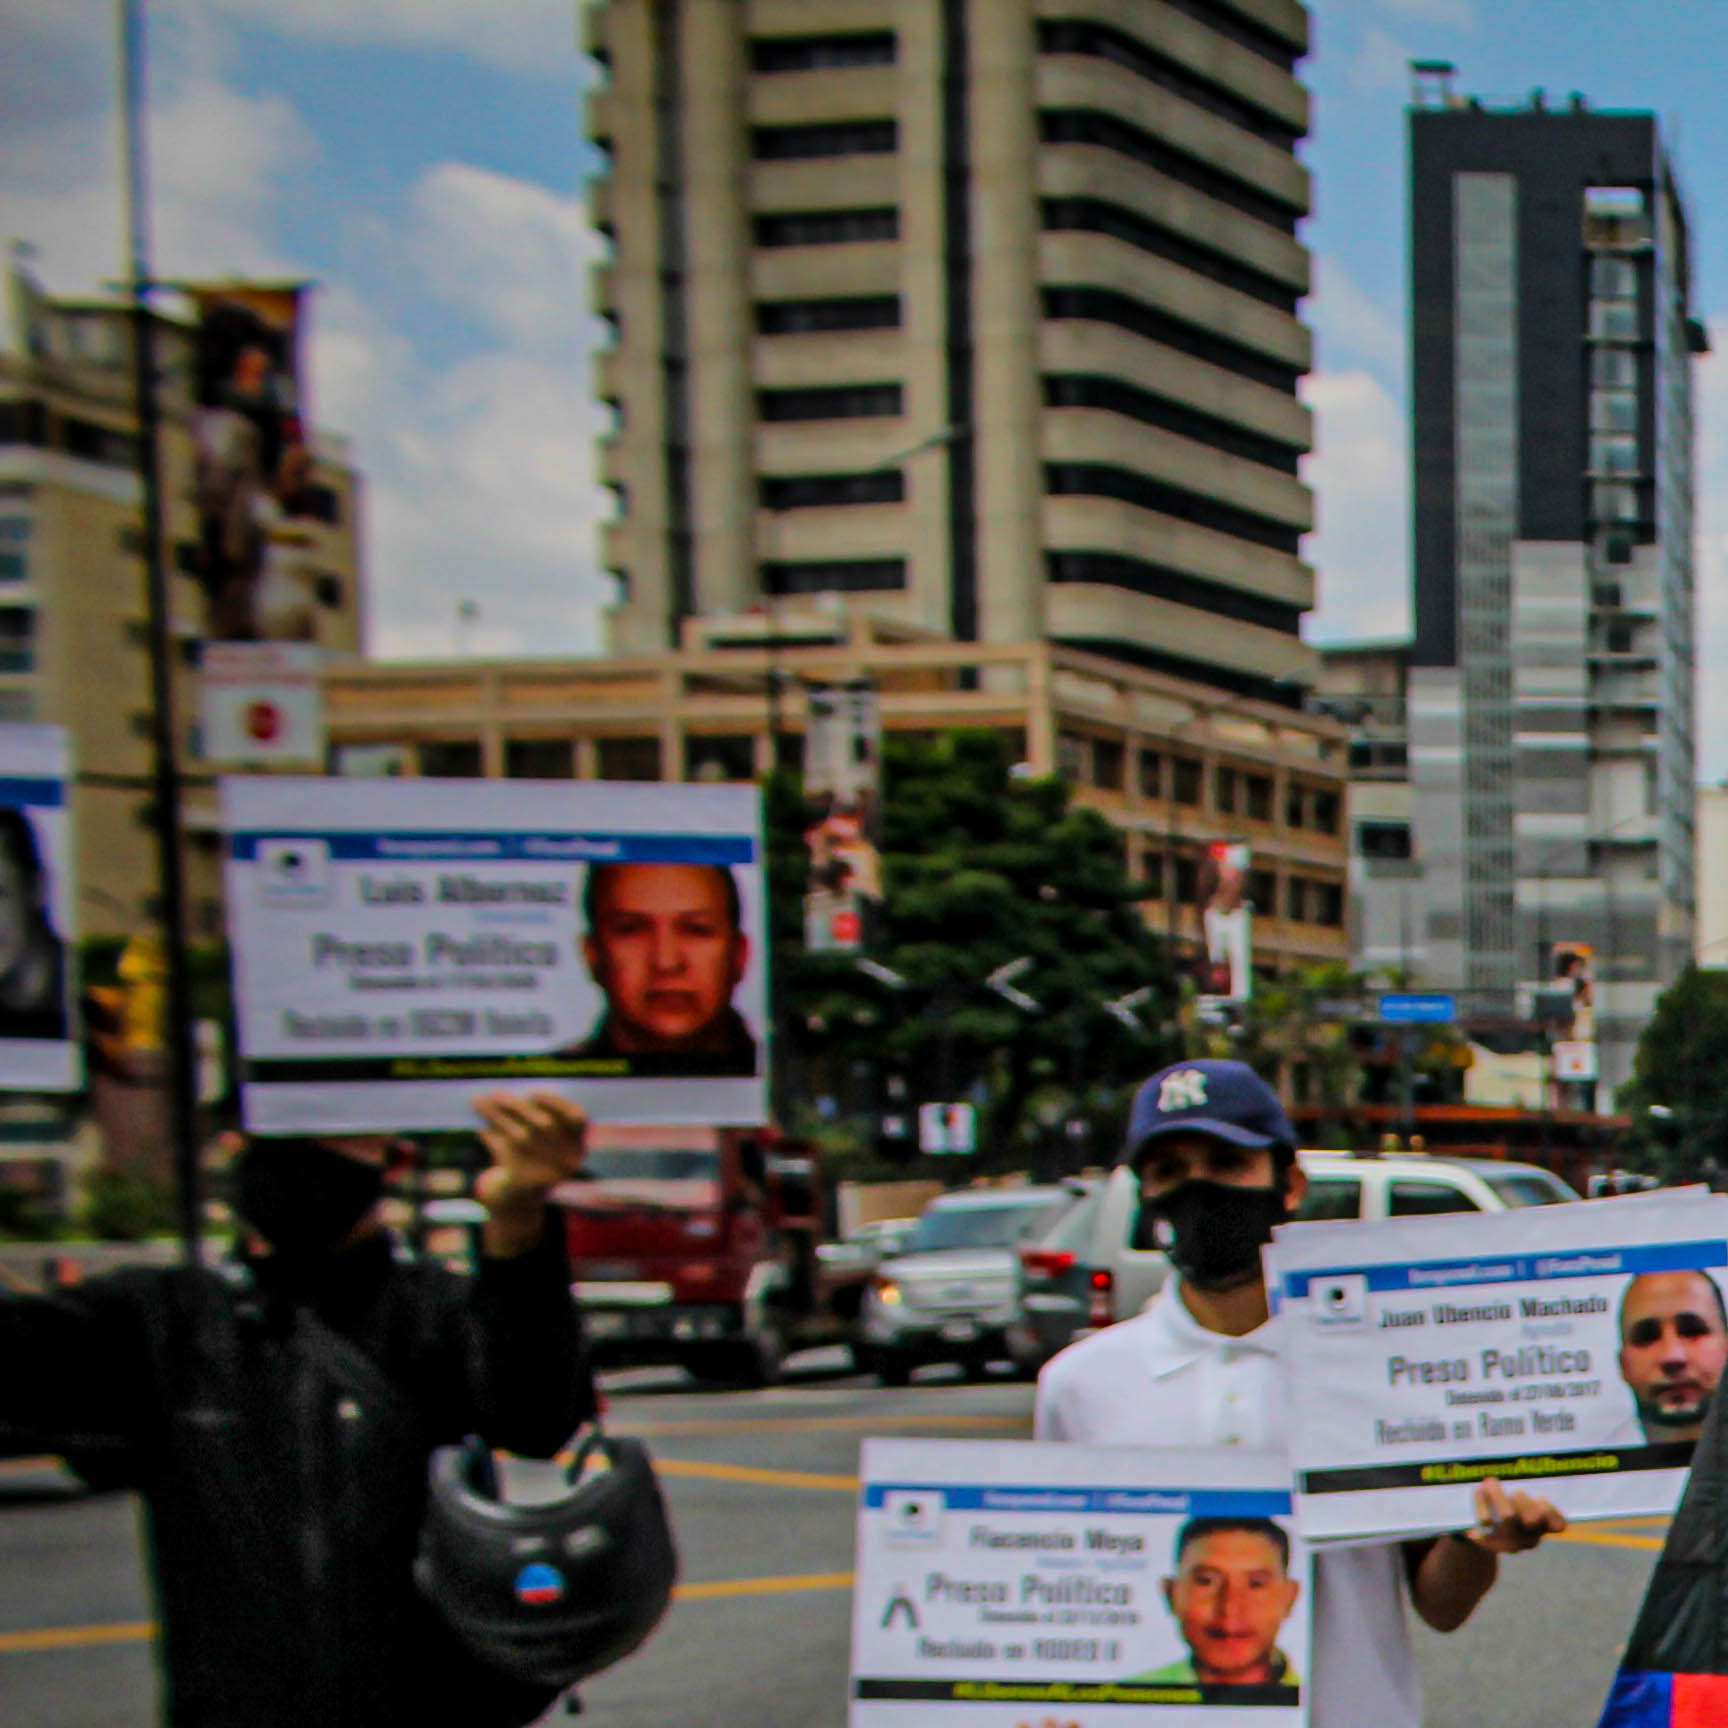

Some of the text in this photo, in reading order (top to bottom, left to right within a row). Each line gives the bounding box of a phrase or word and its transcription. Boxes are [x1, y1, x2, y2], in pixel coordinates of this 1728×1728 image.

[1379, 1305, 1425, 1330] Juan
[1520, 1295, 1608, 1318] Machado
[1388, 1344, 1590, 1386] Preso Político
